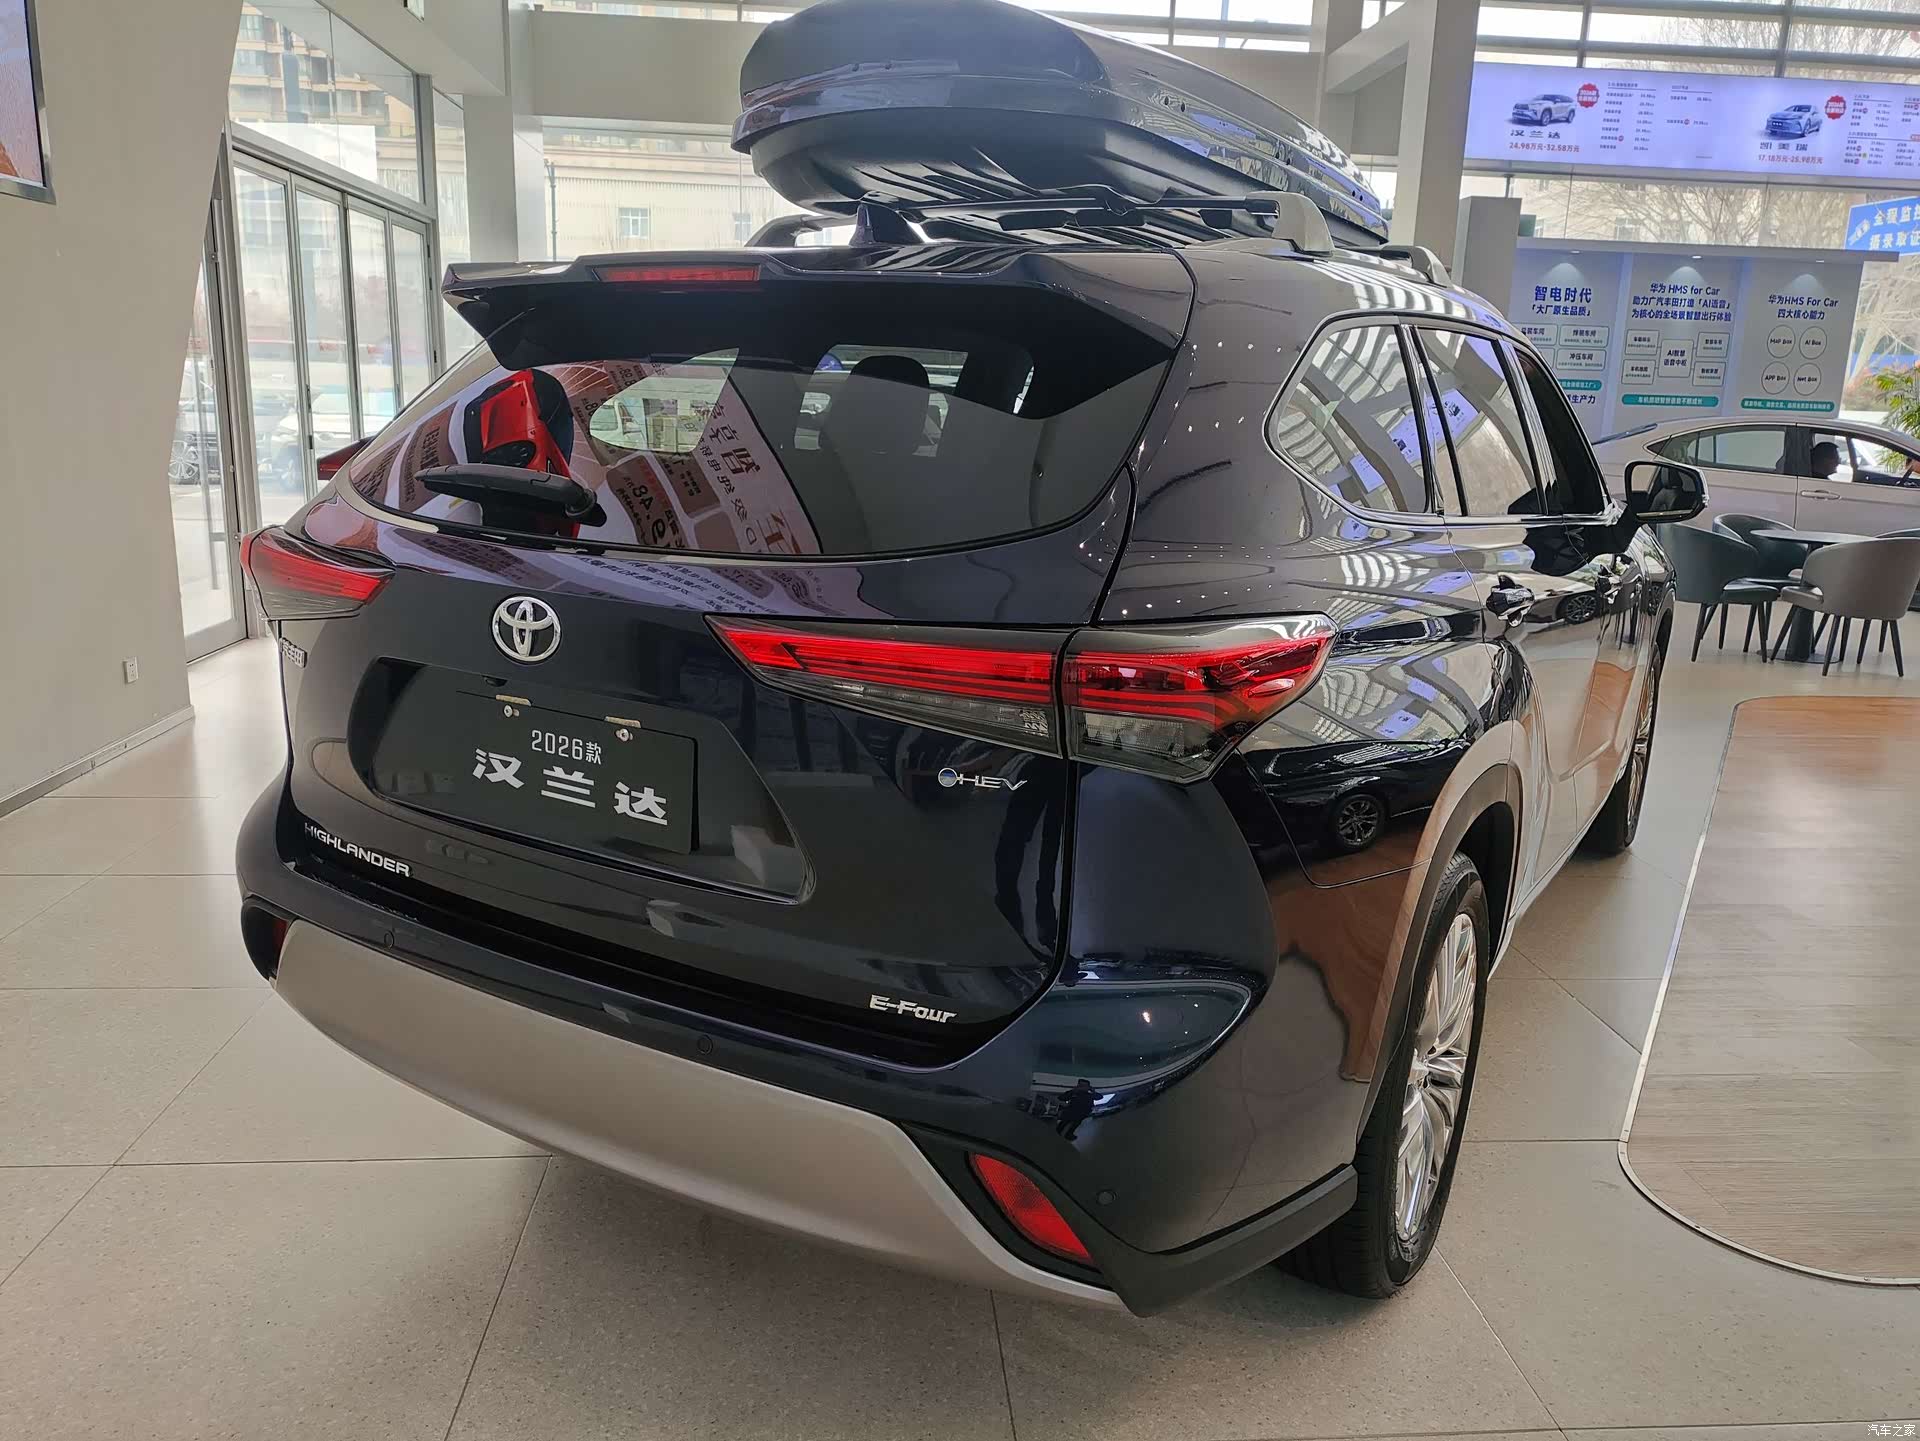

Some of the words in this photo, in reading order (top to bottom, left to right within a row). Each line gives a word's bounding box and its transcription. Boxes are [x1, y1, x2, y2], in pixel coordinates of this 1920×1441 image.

[1534, 285, 1592, 303] 智电时代
[1650, 283, 1666, 293] 华为
[1668, 285, 1688, 294] HMS
[1690, 285, 1703, 295] for
[1705, 287, 1720, 296] Car
[1806, 297, 1821, 306] For
[1823, 298, 1838, 307] Car
[1631, 309, 1732, 322] 为核心的全场景智慧出行体验
[1777, 309, 1825, 320] 四大核心能力
[531, 729, 602, 765] 2026款
[472, 748, 668, 826] 汉兰达
[304, 822, 411, 878] HIGHLANDER
[869, 994, 958, 1023] E-Four
